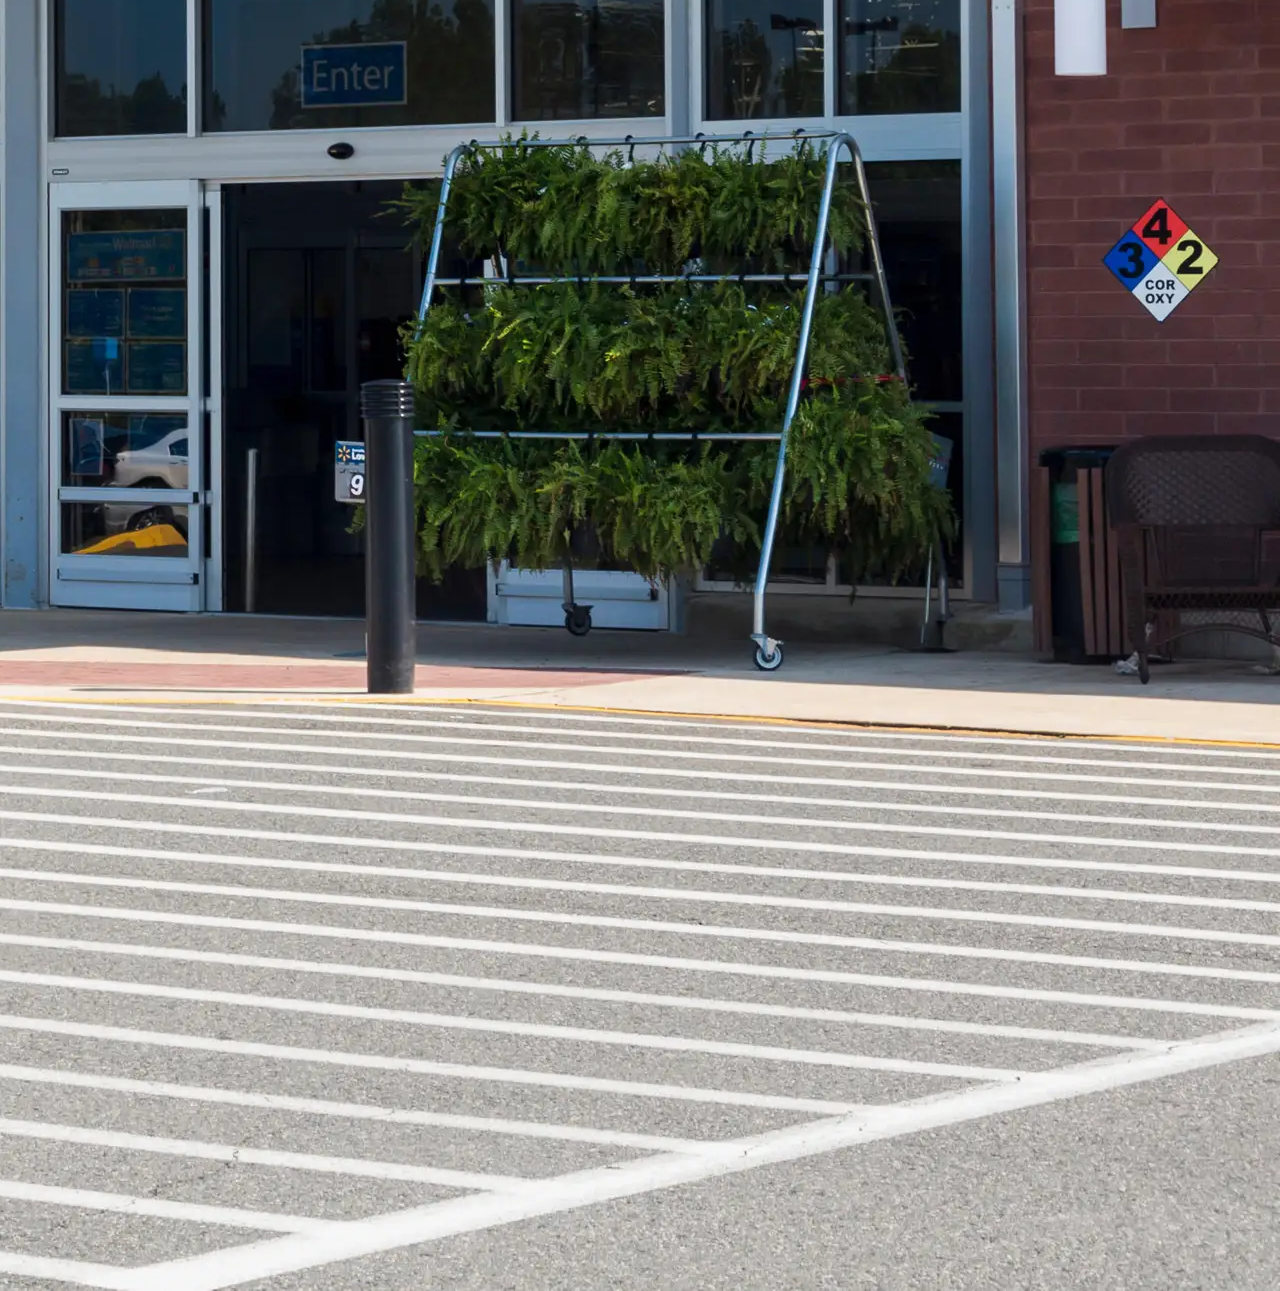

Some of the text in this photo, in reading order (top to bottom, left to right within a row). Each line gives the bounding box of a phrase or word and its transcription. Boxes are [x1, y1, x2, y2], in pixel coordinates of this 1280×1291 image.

[312, 60, 394, 92] Enter
[1142, 208, 1172, 244] 4
[1117, 242, 1144, 278] 3
[1176, 240, 1203, 274] 2
[1145, 279, 1175, 290] COR
[1145, 293, 1175, 304] OXY
[350, 474, 364, 495] 9
